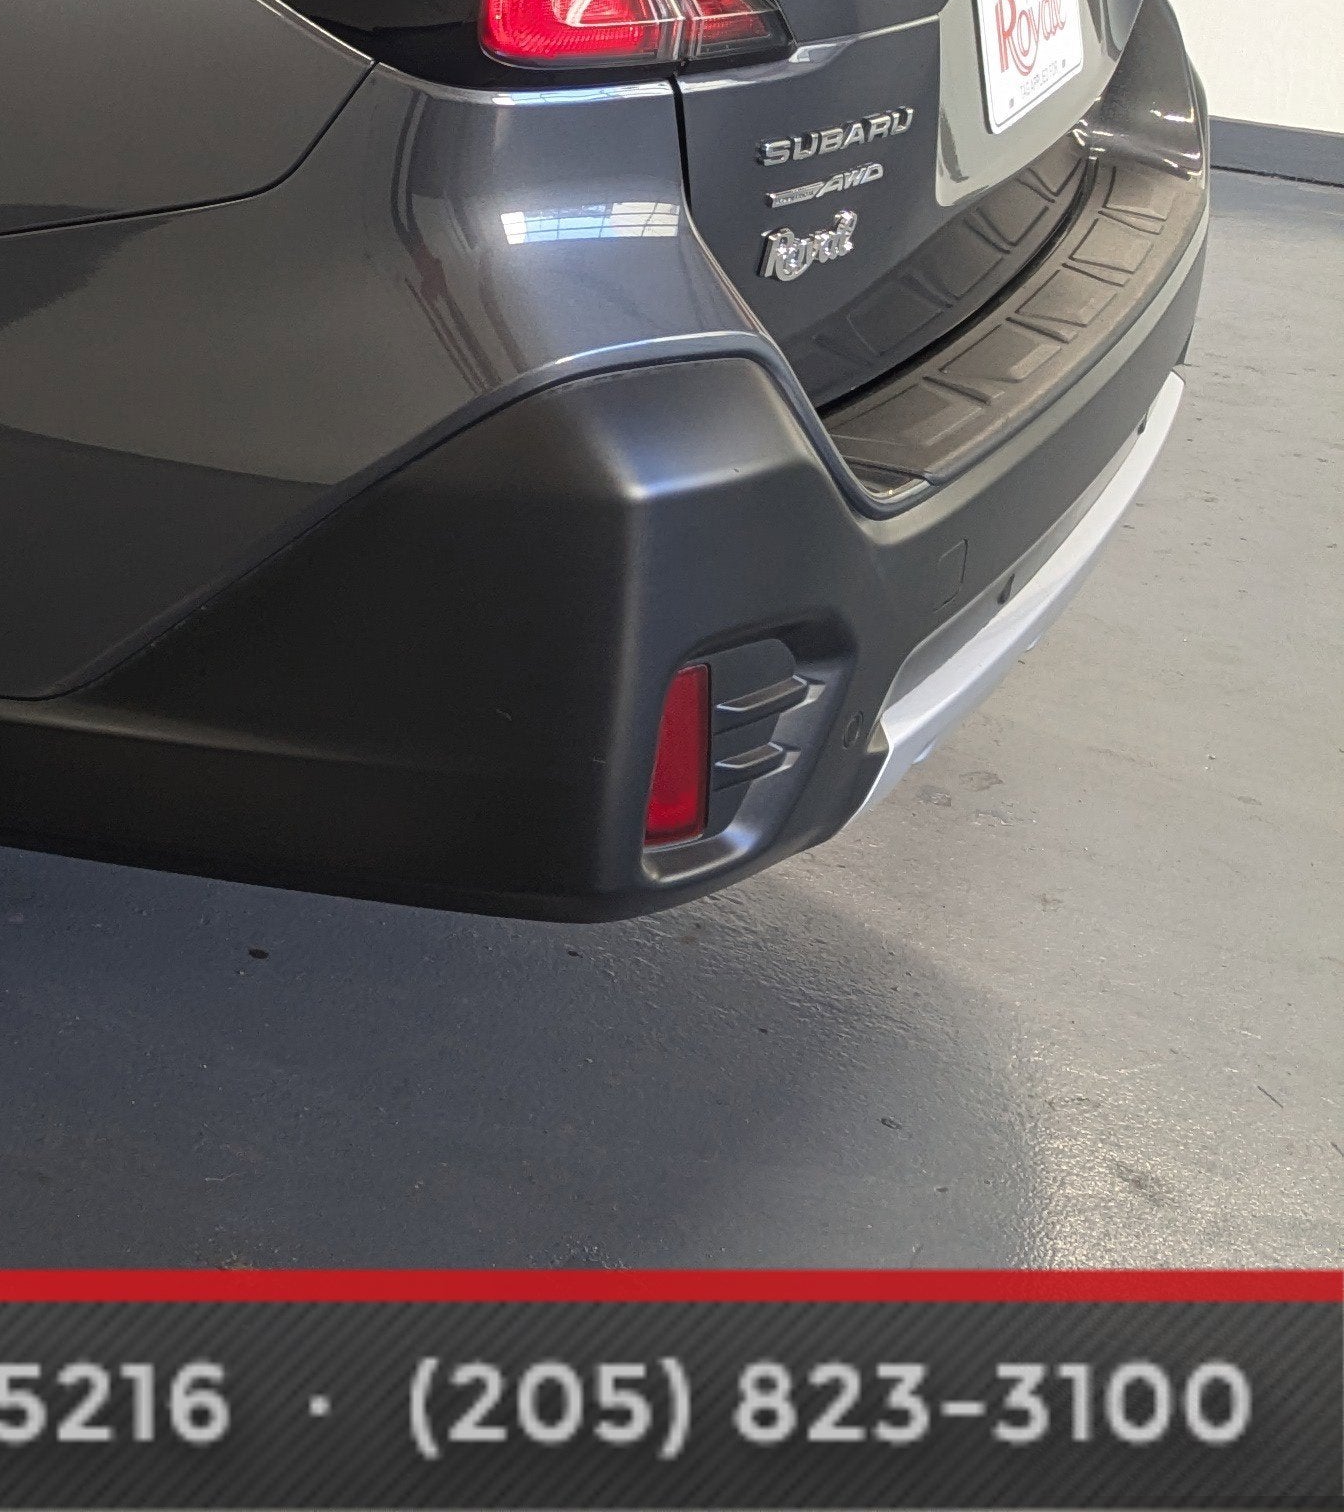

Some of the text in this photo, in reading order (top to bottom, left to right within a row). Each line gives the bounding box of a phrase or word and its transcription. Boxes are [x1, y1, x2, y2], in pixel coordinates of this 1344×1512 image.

[758, 106, 913, 166] SUBARU
[816, 162, 884, 198] AWD
[761, 208, 859, 281] Royal
